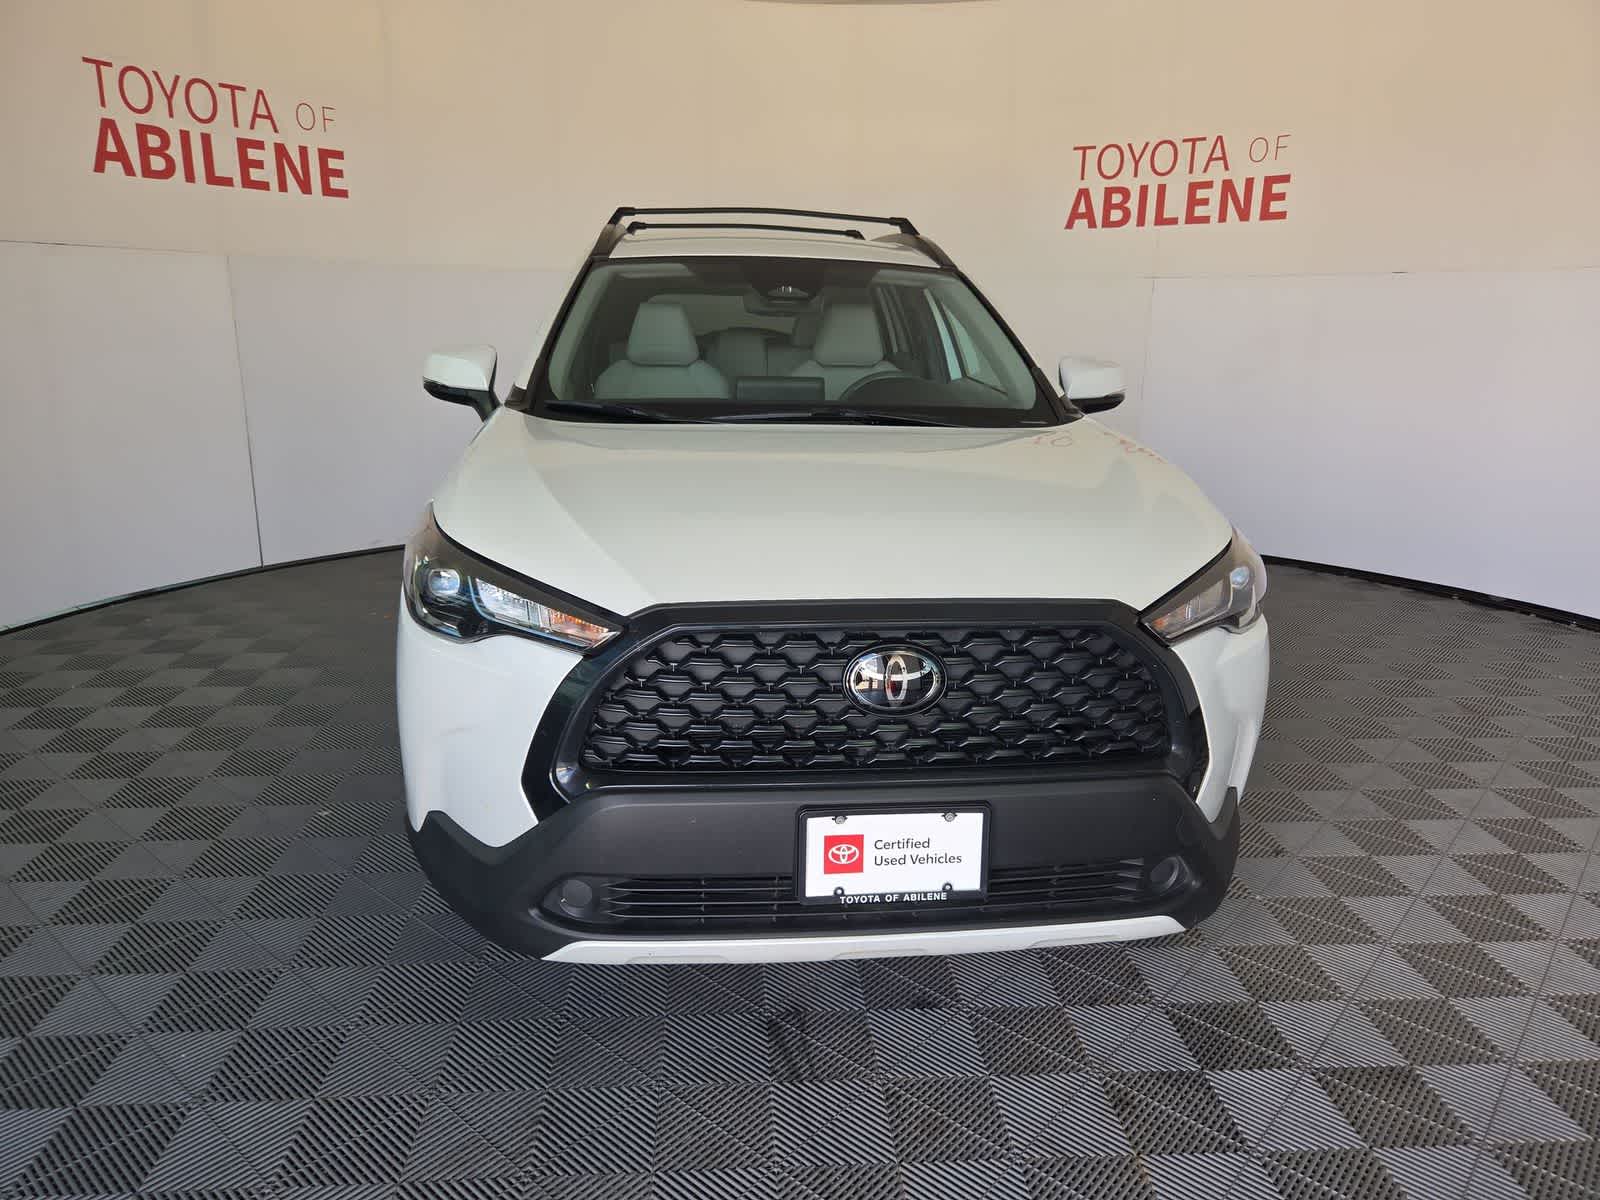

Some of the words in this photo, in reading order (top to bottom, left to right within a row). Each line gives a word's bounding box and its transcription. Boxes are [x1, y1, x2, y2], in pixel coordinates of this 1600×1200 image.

[82, 57, 278, 133] TOYOTA
[295, 103, 336, 133] OF
[93, 118, 350, 199] ABILENE
[1073, 135, 1231, 181] TOYOTA
[1249, 134, 1291, 163] OF
[1065, 174, 1291, 230] ABILENE
[874, 838, 930, 850] Certified
[874, 855, 906, 866] Used
[910, 853, 963, 865] Vehicles
[840, 896, 880, 904] TOYOTA
[903, 892, 948, 901] ABILENE
